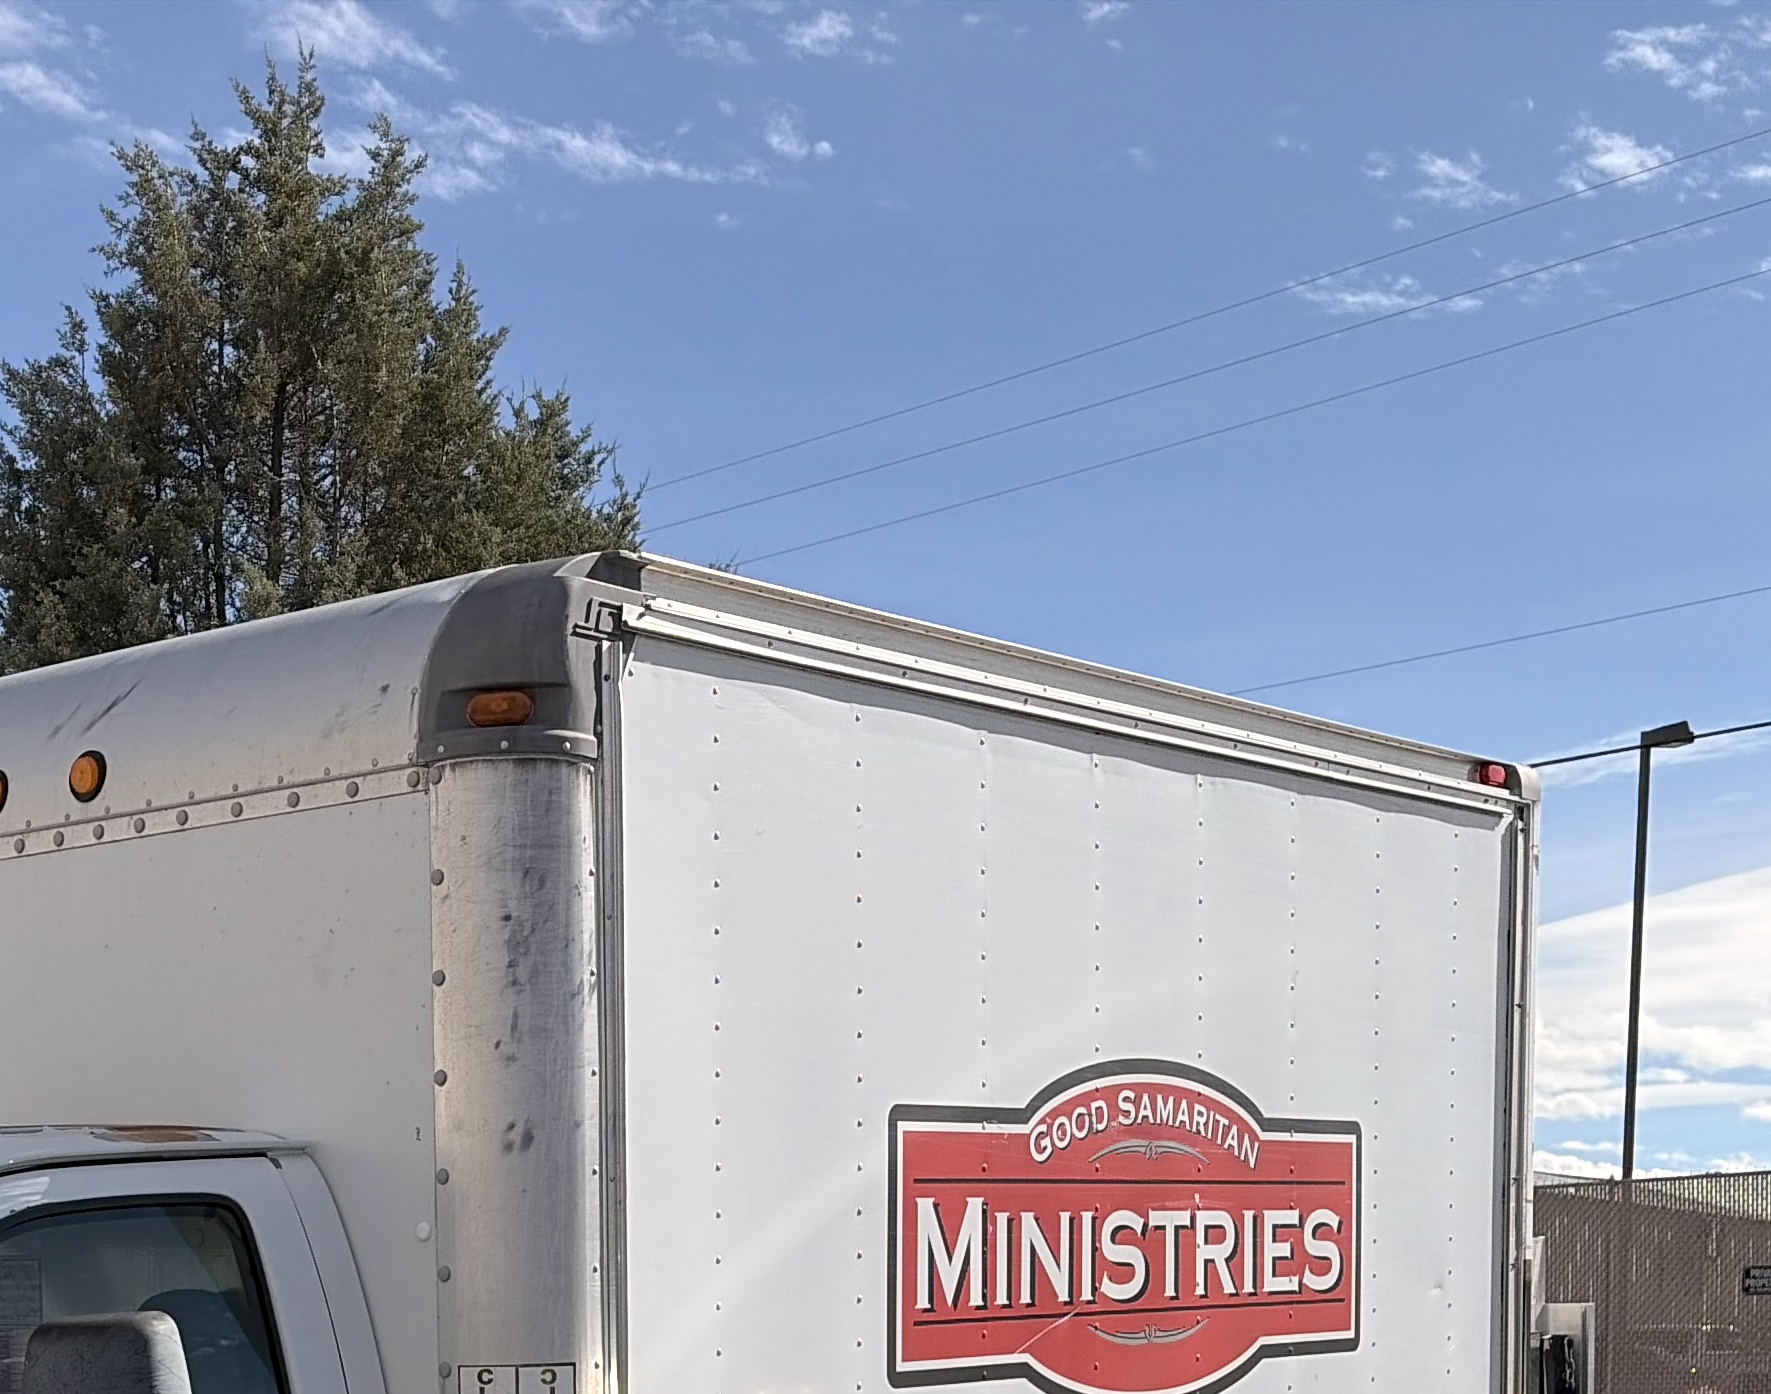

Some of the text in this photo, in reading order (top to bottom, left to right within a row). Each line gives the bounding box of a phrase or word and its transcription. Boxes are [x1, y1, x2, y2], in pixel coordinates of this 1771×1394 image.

[1028, 1089, 1261, 1171] GOOD SAMARITAN
[914, 1194, 1345, 1312] MINISTRIES
